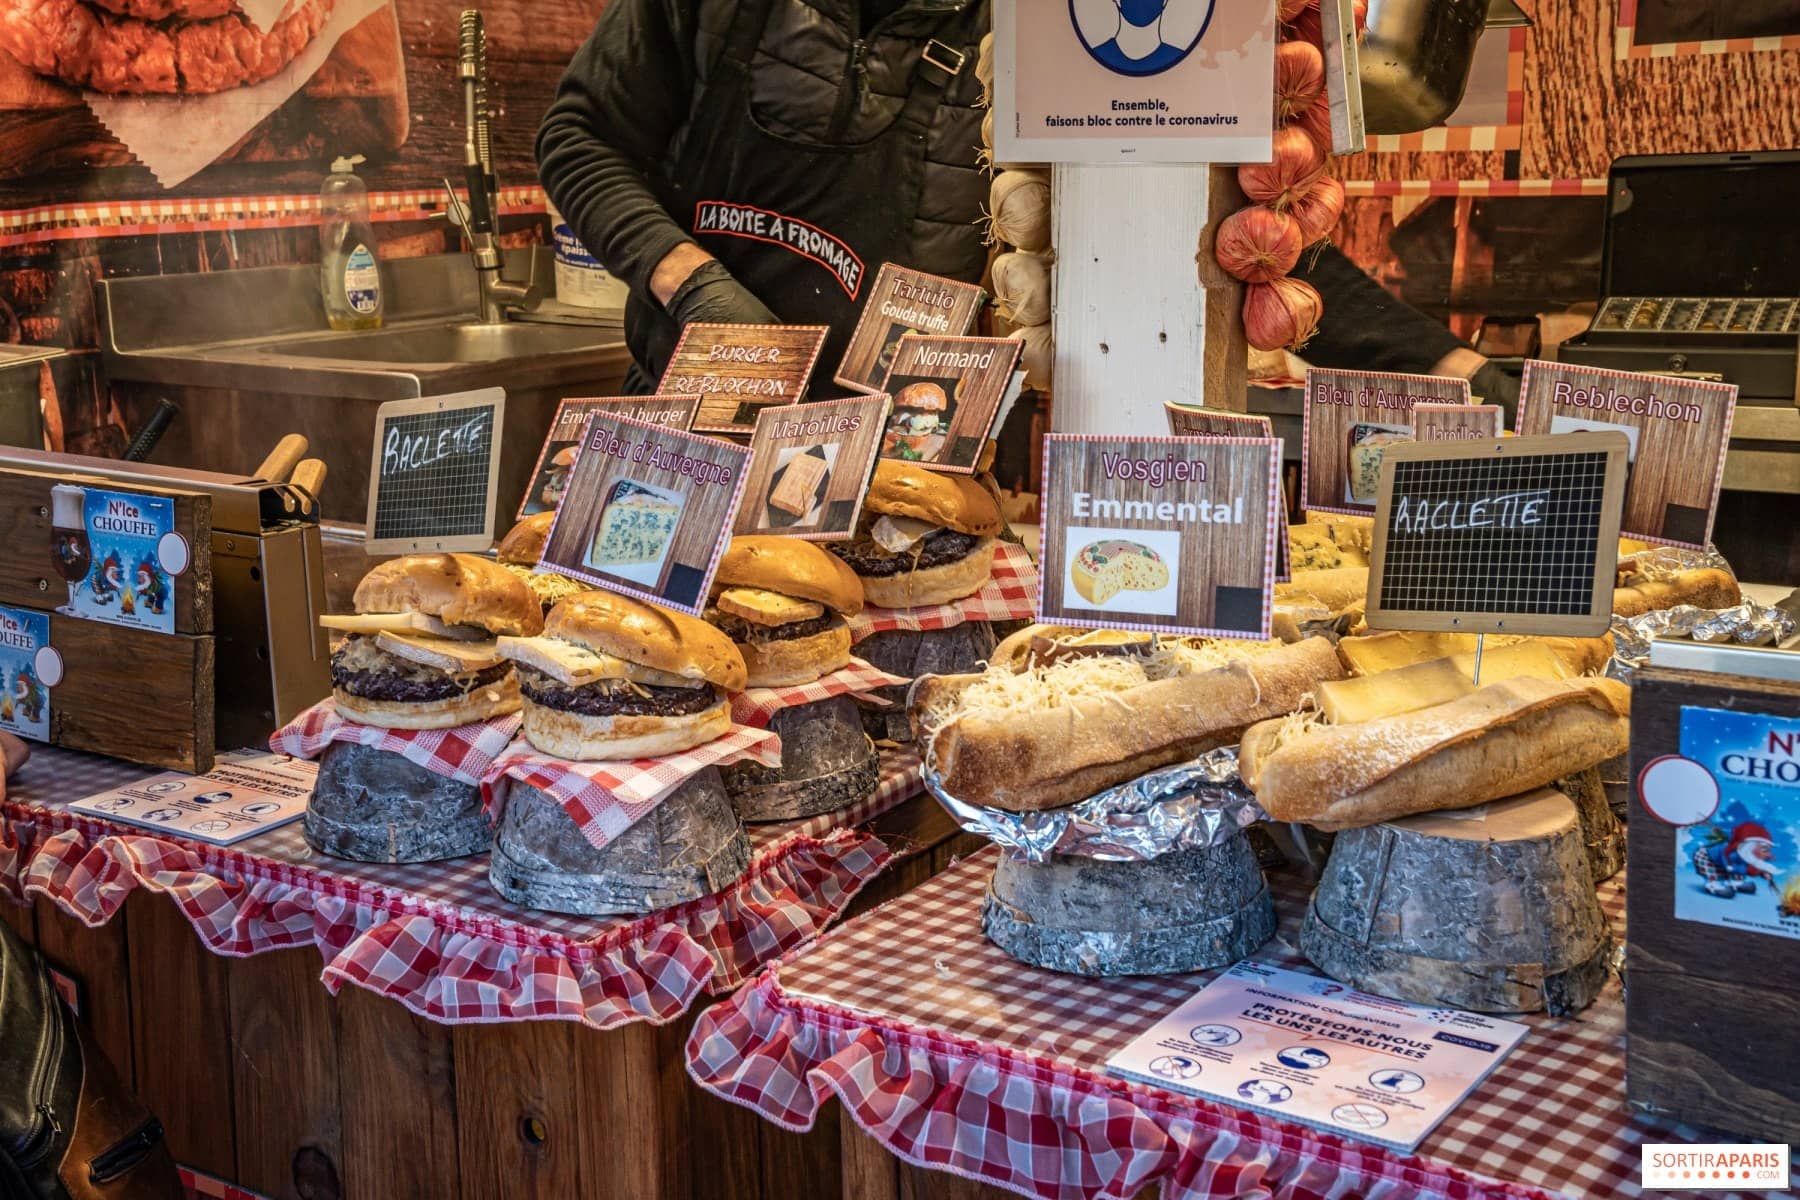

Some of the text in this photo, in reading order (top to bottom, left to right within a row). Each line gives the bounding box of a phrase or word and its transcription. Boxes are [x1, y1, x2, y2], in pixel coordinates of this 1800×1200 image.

[1111, 100, 1169, 112] Ensemble,
[1045, 113, 1238, 127] faisons bloc contre le coronavirus
[700, 206, 717, 229] LA
[719, 207, 766, 234] BOITE
[788, 223, 860, 291] FROMAGE
[891, 278, 955, 311] Tartufo
[881, 300, 917, 323] Gouda
[709, 344, 780, 363] BURGER
[914, 345, 995, 369] Normand
[675, 376, 788, 396] REBLOCHON
[1316, 383, 1354, 406] Bleu
[1553, 380, 1704, 424] Reblechon
[637, 407, 687, 426] burger
[769, 414, 863, 440] Maroilles
[383, 411, 489, 477] RACLETTE
[590, 427, 732, 486] Bleu d'Auvergne
[1102, 451, 1208, 489] Vosgien
[109, 501, 139, 518] N'Ice
[1072, 491, 1243, 525] Emmental
[1394, 490, 1551, 534] RACLETTE
[93, 515, 157, 537] CHOUFFE
[1245, 987, 1320, 1009] INFORMATION
[1242, 1009, 1427, 1060] LES UNS LES AUTRES
[1252, 1002, 1434, 1051] PROTÉGEONS-NOUS
